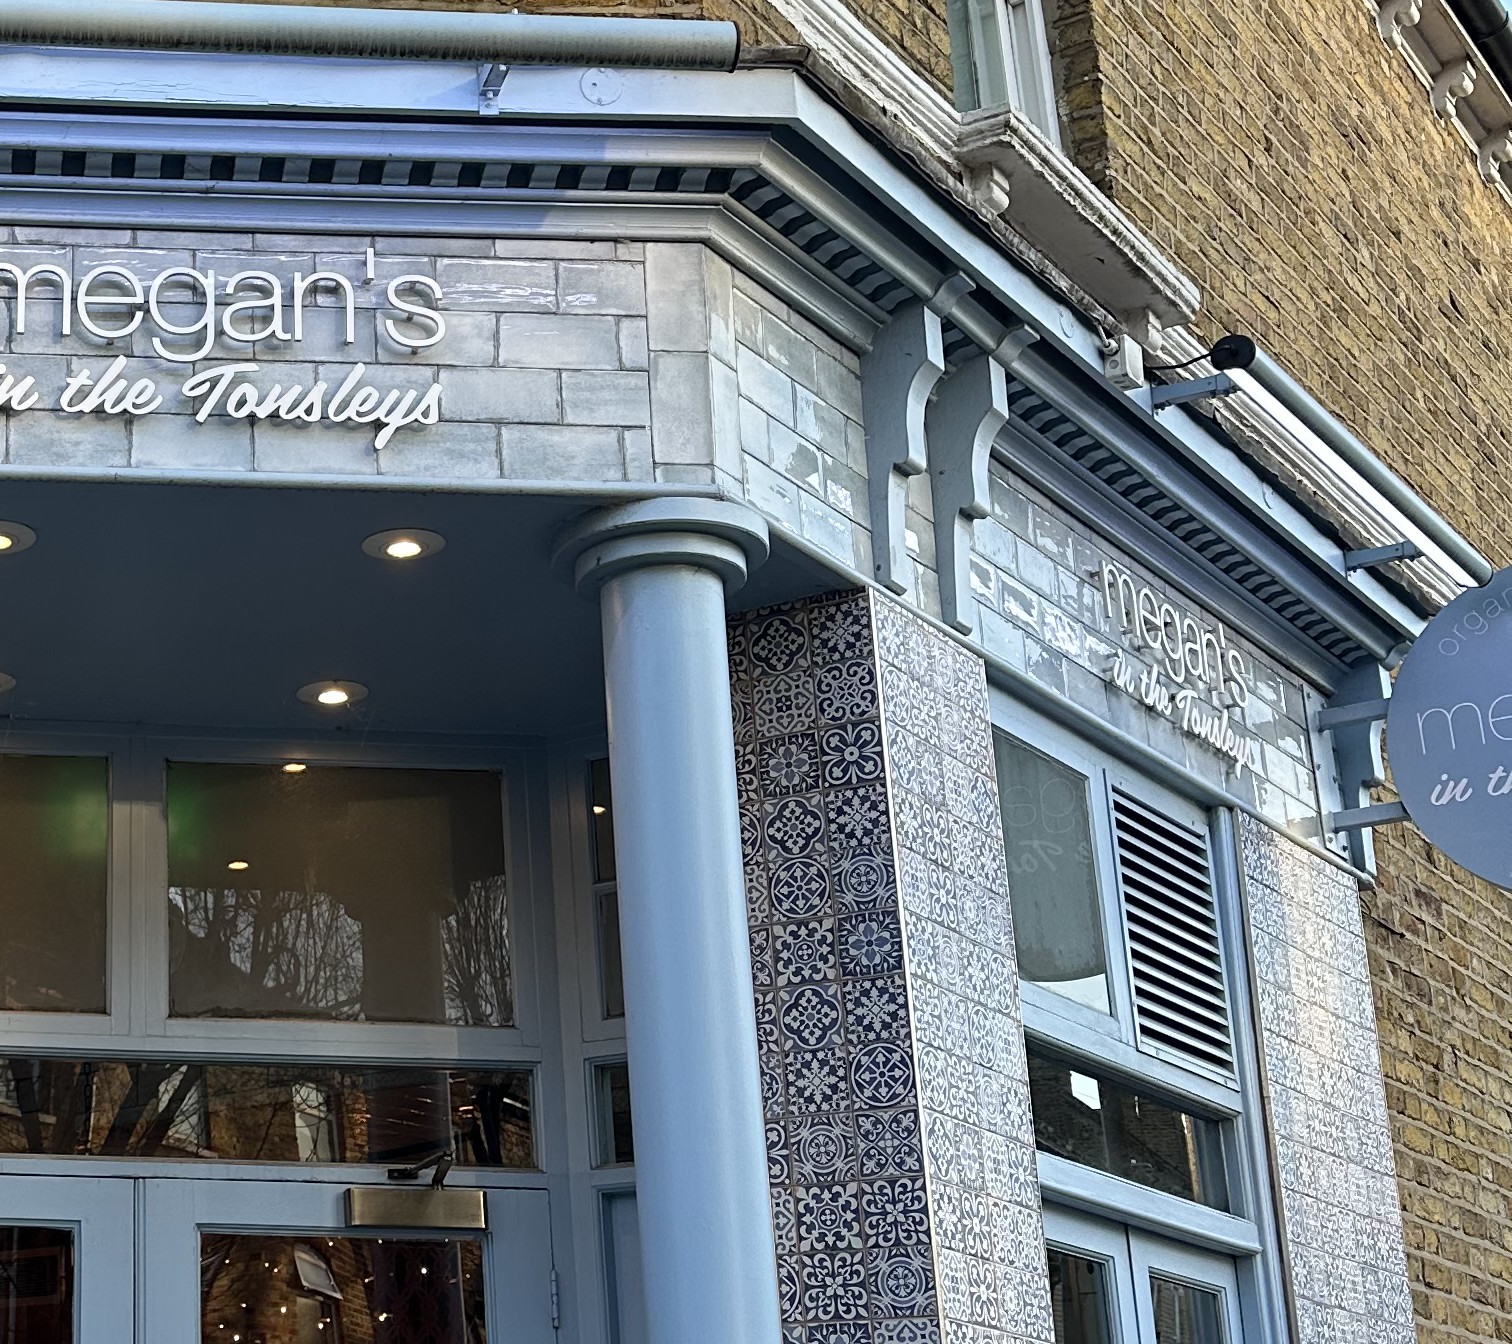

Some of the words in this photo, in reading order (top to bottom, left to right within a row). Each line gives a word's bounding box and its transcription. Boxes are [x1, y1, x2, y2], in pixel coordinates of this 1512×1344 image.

[59, 355, 163, 415] the
[181, 362, 442, 451] Tonsleys
[1098, 559, 1249, 708] megan's
[1112, 648, 1135, 693] in
[1139, 663, 1172, 716] the
[1175, 689, 1256, 779] Tonsleys
[1416, 693, 1512, 756] me
[1430, 773, 1473, 807] in
